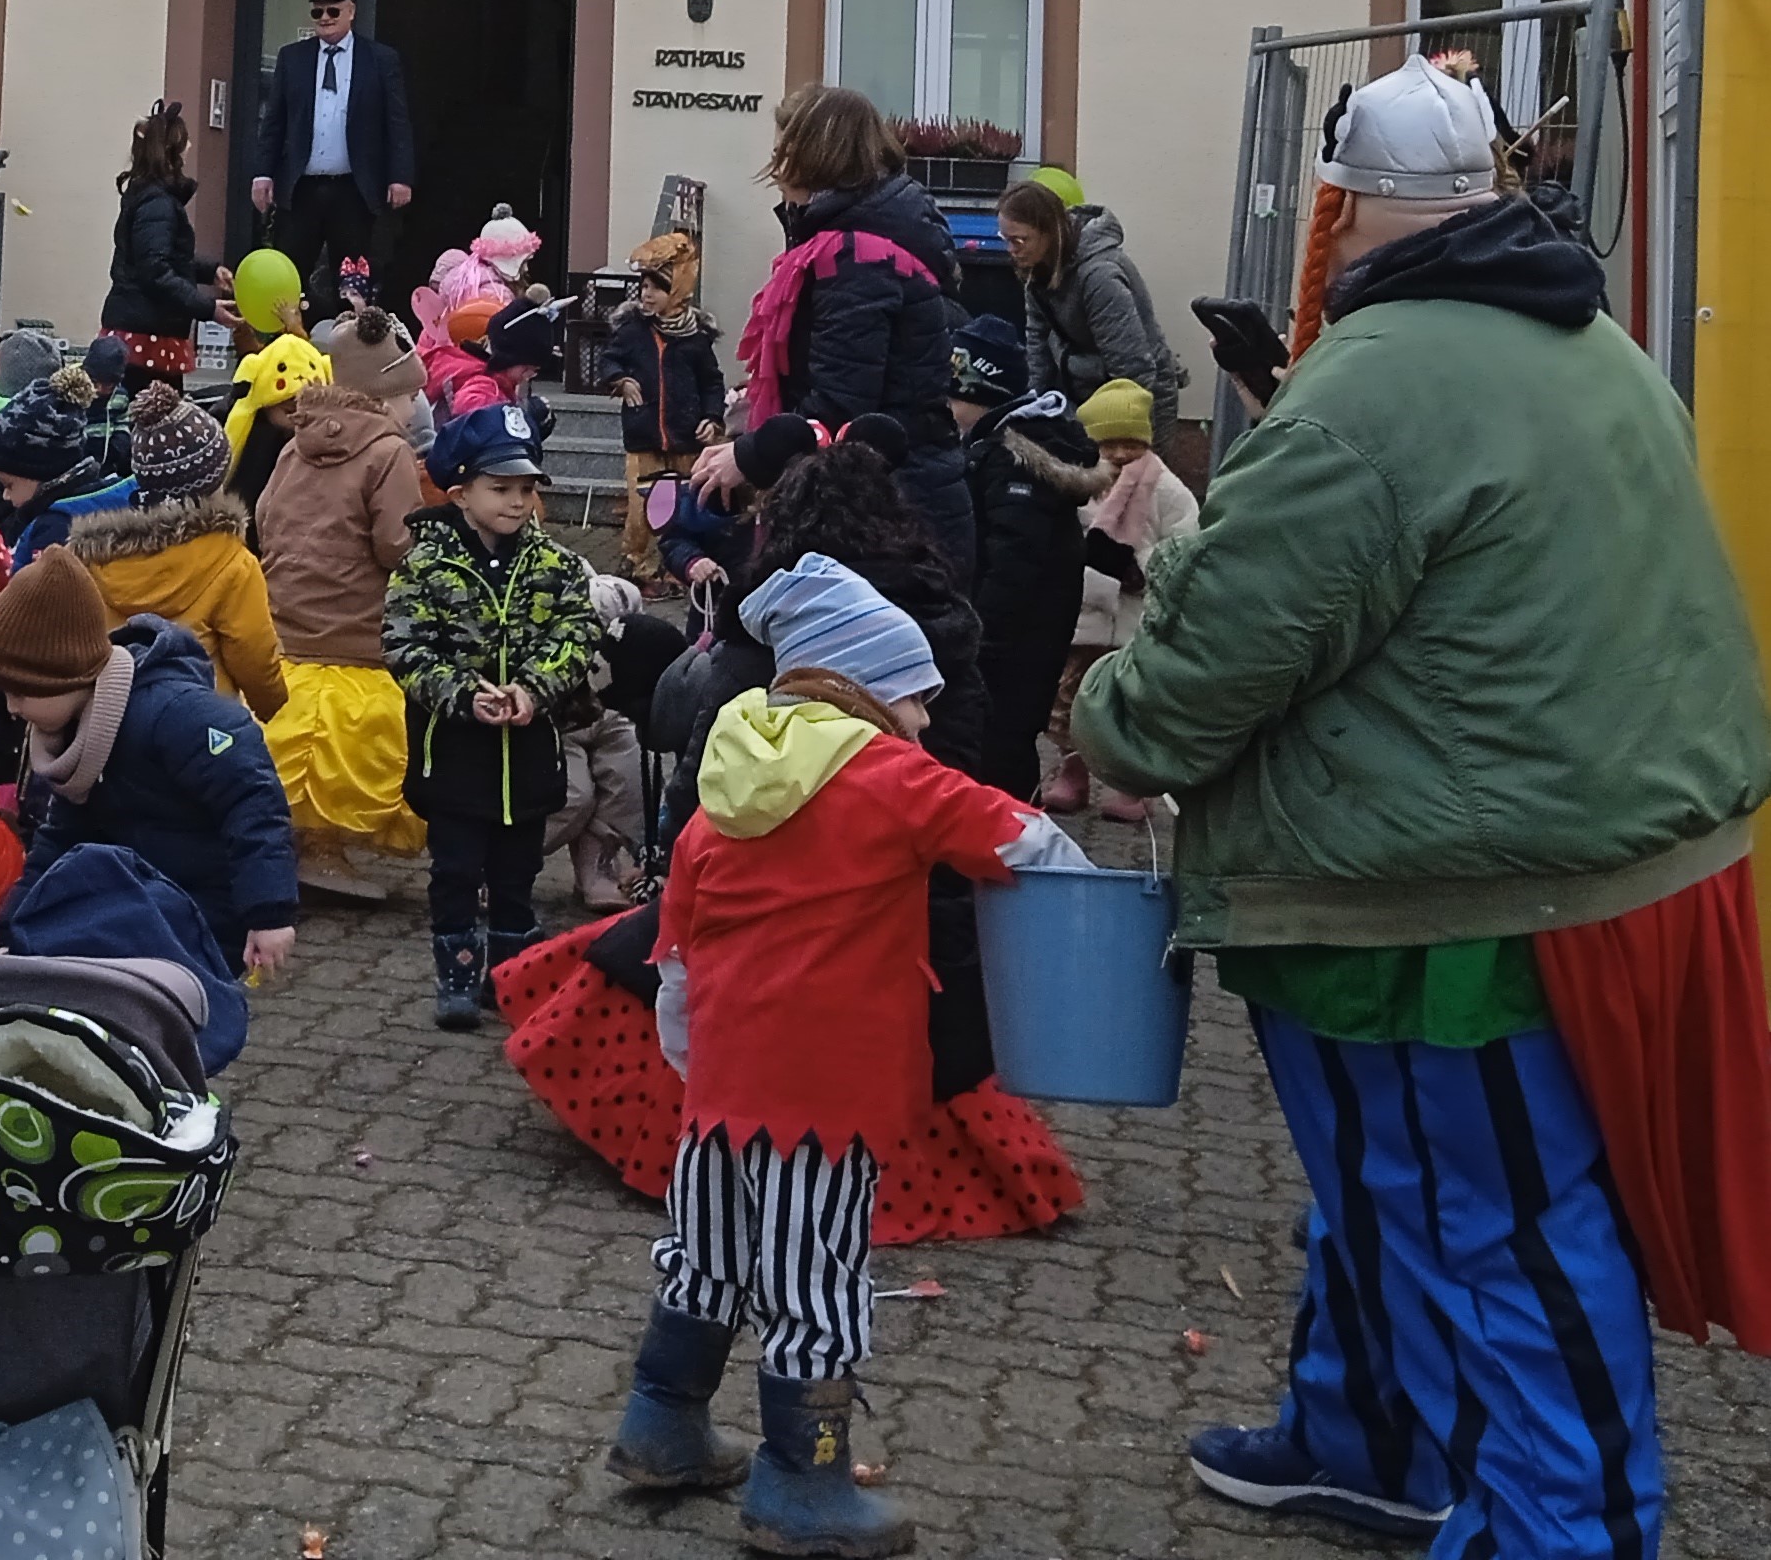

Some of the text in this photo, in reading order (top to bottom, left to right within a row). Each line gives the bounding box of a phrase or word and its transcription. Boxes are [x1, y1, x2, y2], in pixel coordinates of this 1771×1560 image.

[654, 49, 746, 70] RATHAUS
[632, 89, 764, 113] STANDESAMT
[972, 356, 1004, 377] HEY
